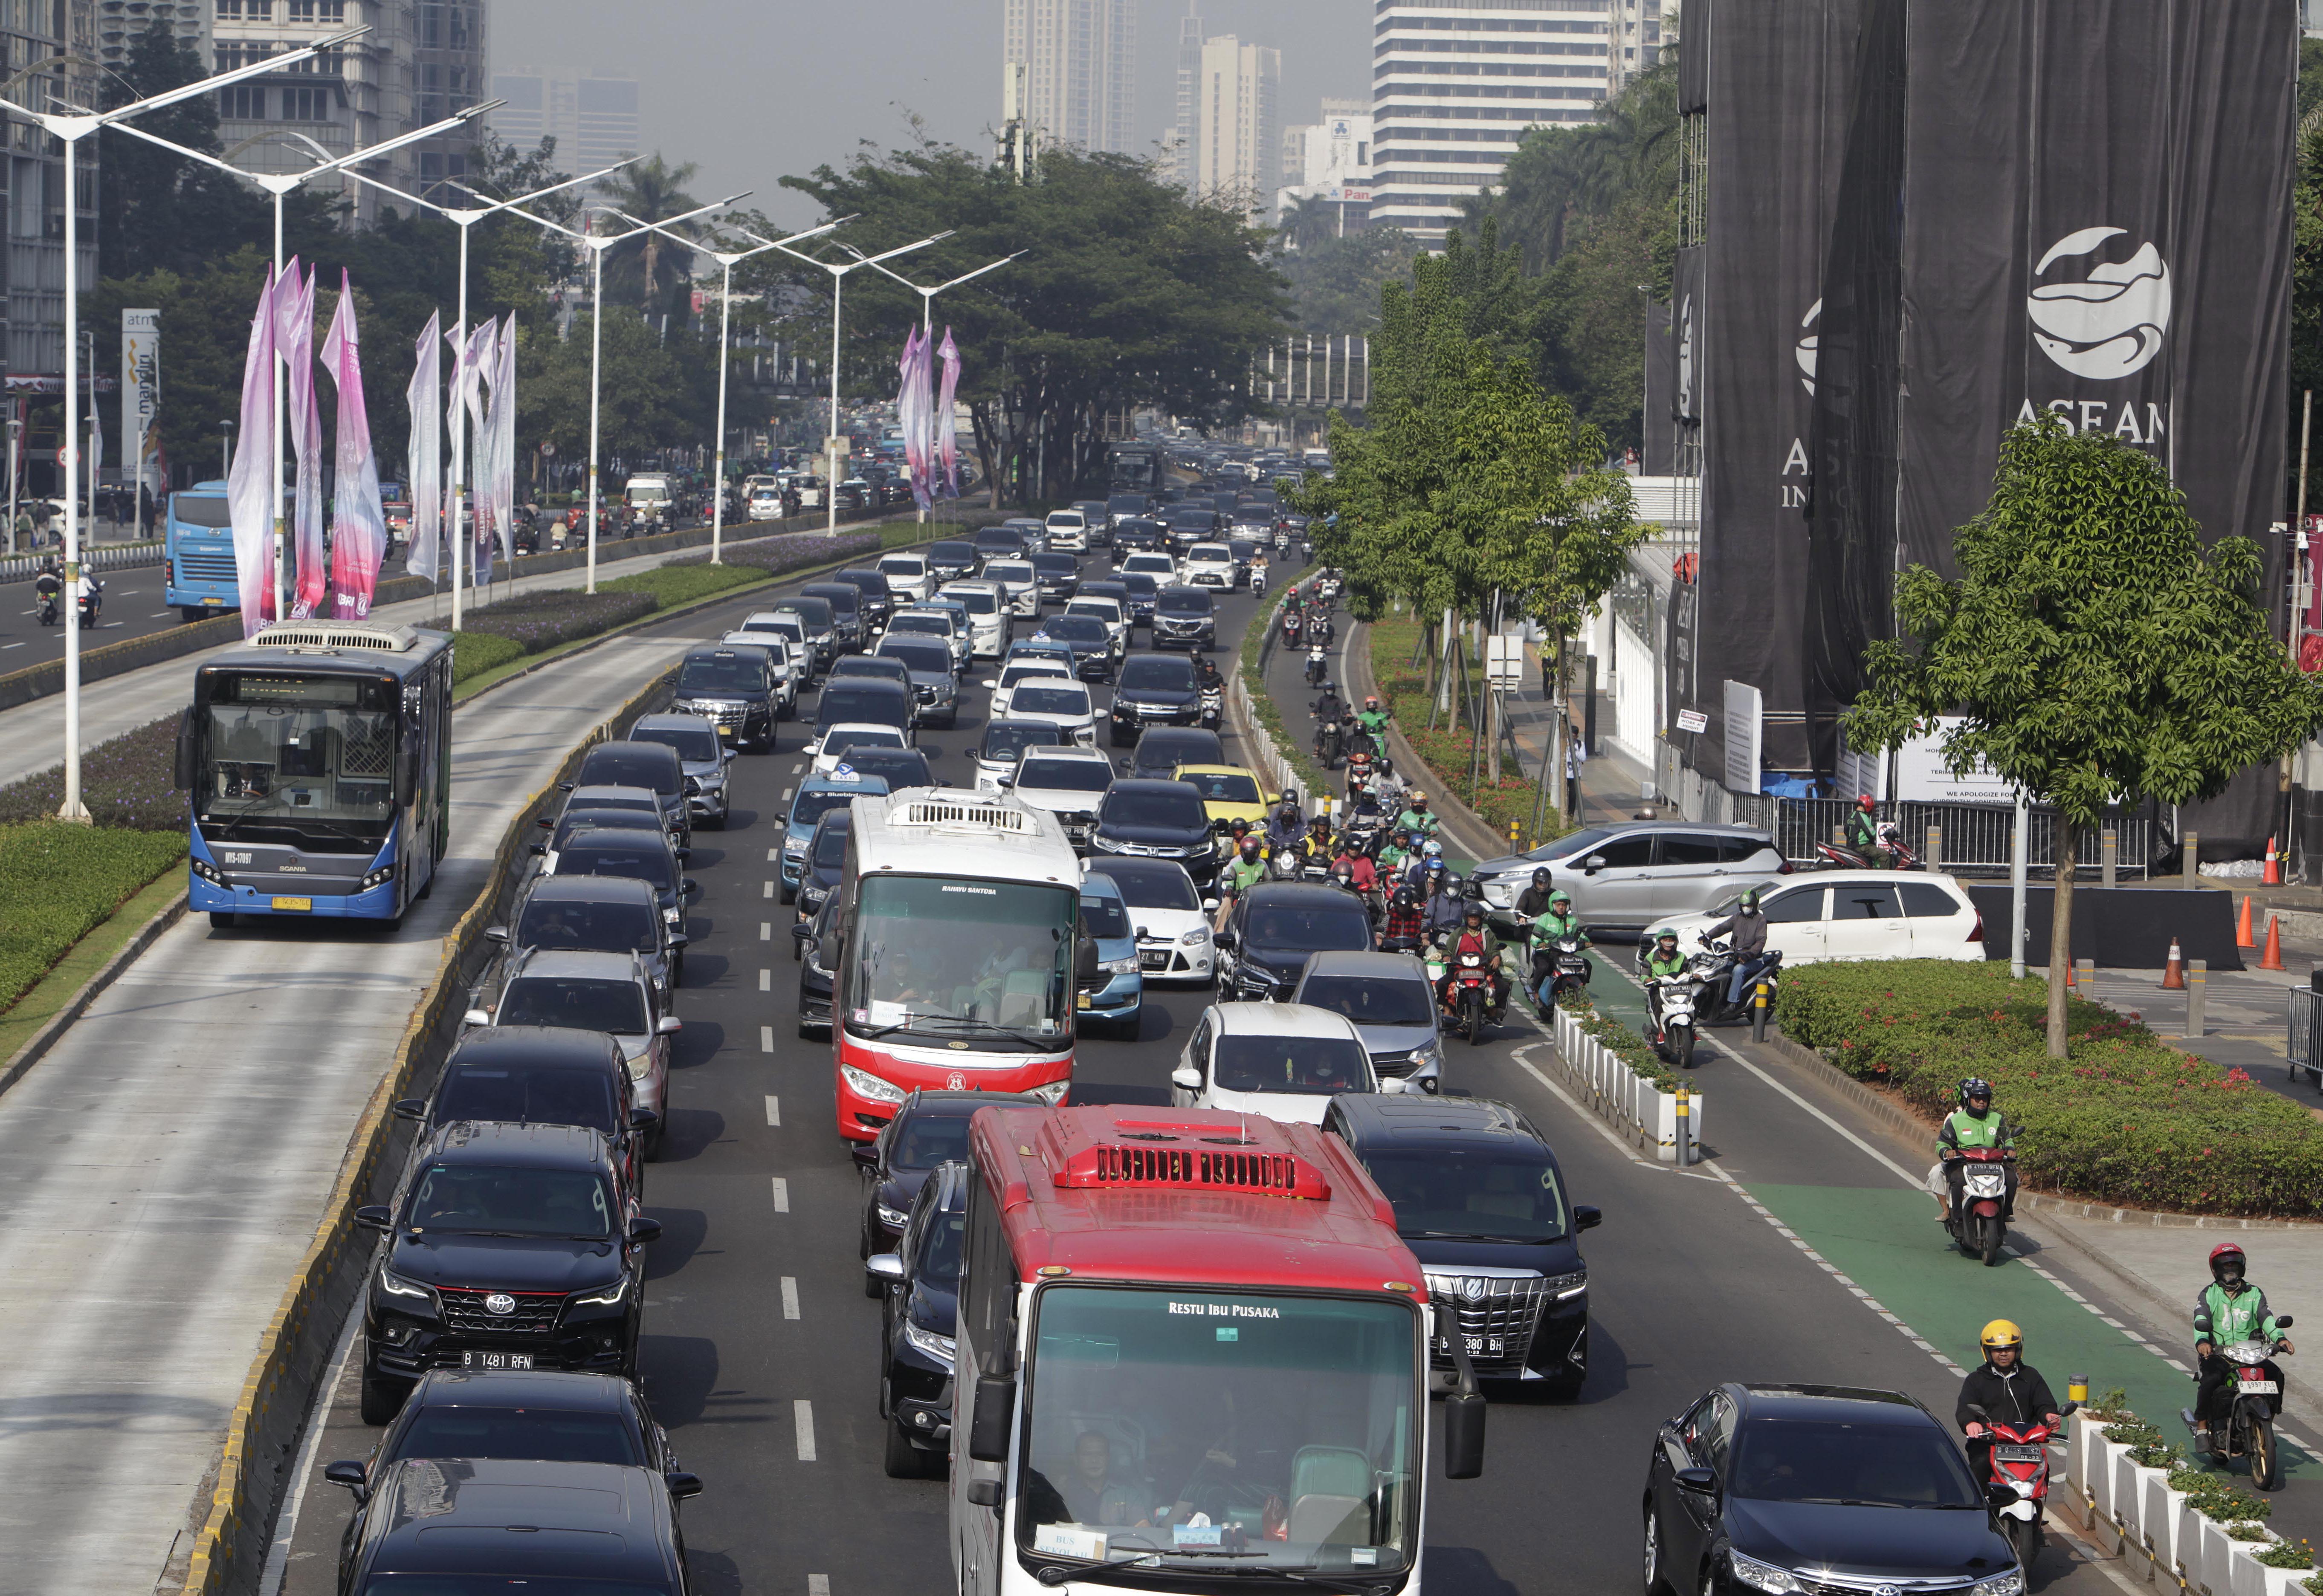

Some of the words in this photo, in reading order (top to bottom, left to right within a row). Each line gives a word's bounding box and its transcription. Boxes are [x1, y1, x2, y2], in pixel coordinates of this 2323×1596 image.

[1344, 189, 1372, 200] Pan
[136, 355, 151, 415] mandiri
[2011, 398, 2167, 443] ASEAN
[225, 852, 252, 864] MYS-17097
[967, 887, 996, 895] SANTOSA
[1169, 1302, 1204, 1315] RESTU
[1209, 1304, 1228, 1316] IBU
[1232, 1305, 1279, 1318] PUSAKA
[1466, 1338, 1482, 1350] 380
[1490, 1339, 1501, 1351] BH
[464, 1353, 471, 1365] B
[482, 1354, 504, 1367] 1481
[512, 1356, 530, 1369] RFN
[1056, 1535, 1075, 1545] BUS
[1040, 1545, 1087, 1558] SEKOLAH
